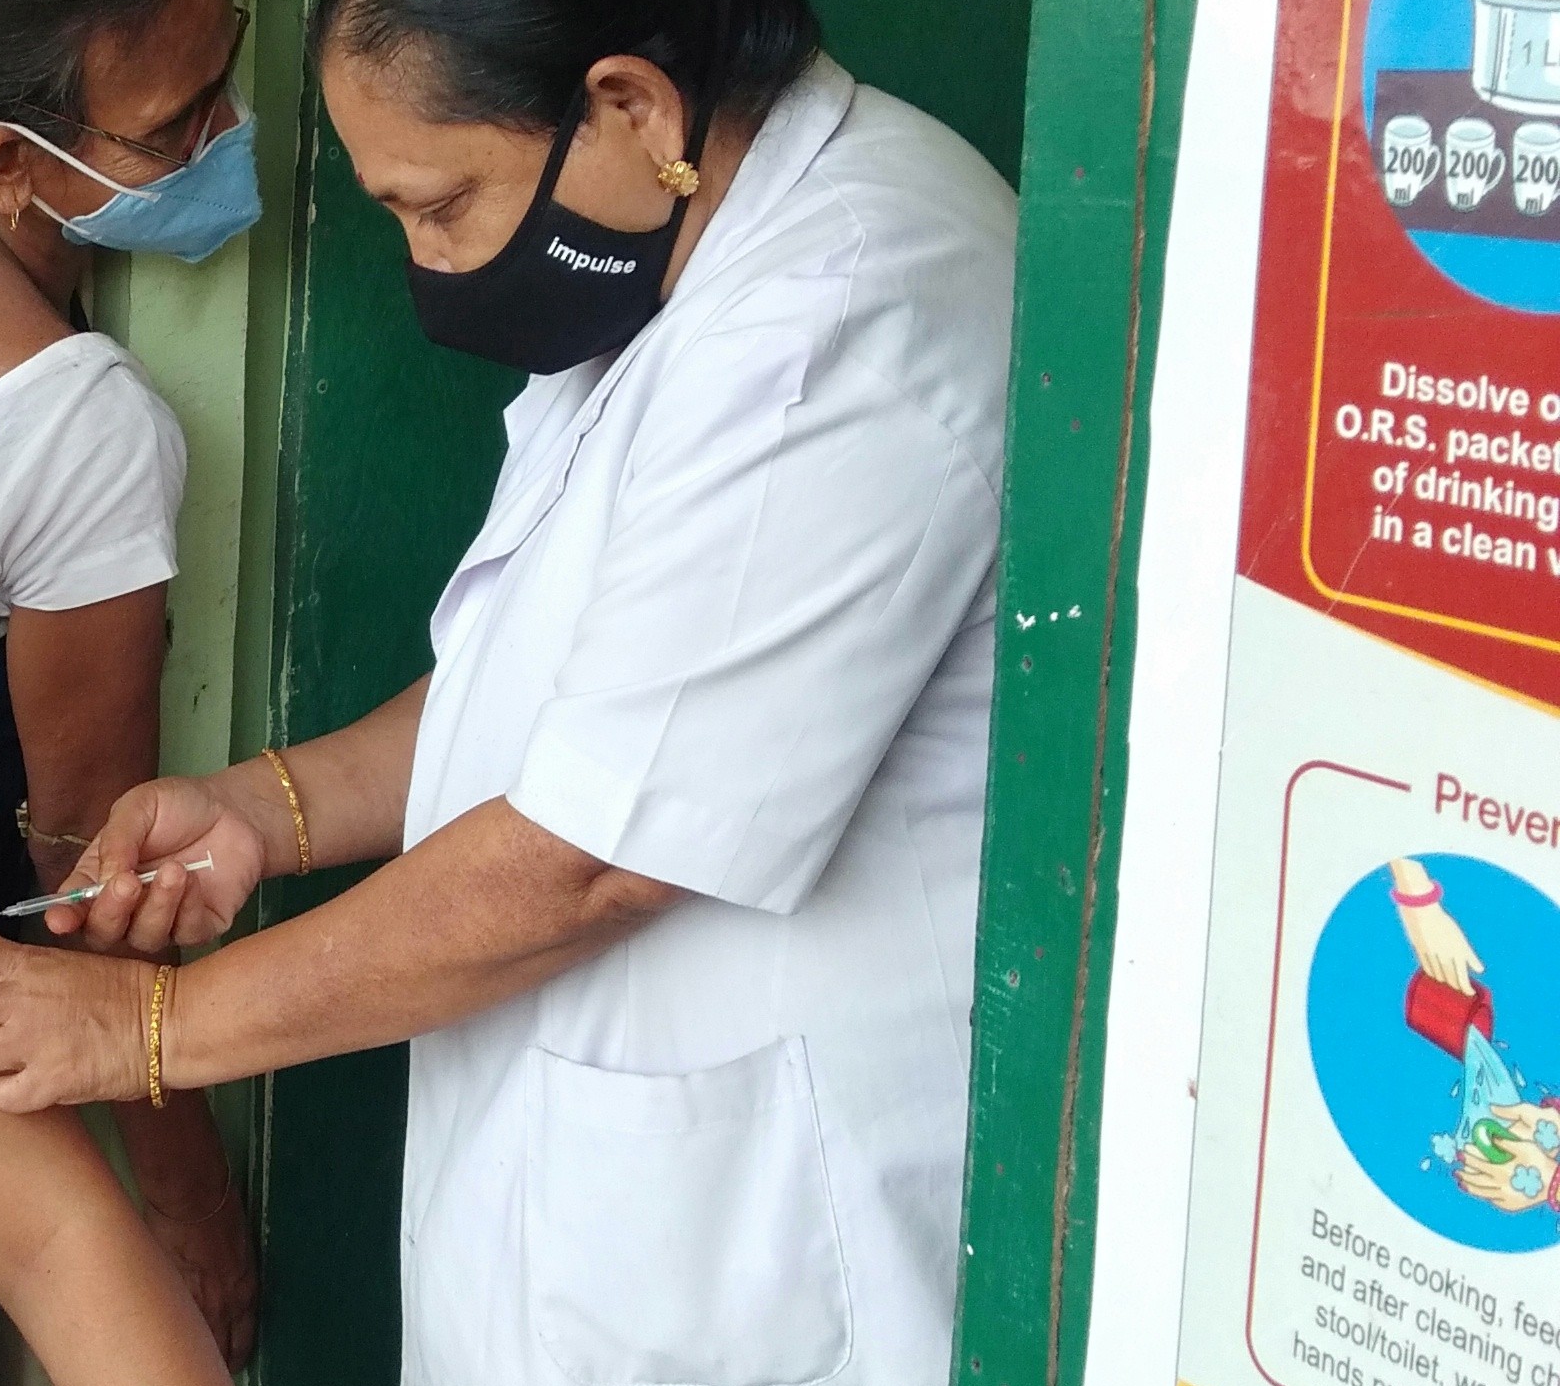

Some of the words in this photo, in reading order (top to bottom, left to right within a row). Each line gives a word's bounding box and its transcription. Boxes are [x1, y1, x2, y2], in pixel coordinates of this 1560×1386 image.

[1385, 146, 1427, 176] 200
[1448, 150, 1491, 180] 200
[1516, 154, 1558, 184] 200
[1393, 185, 1411, 204] ml
[1457, 189, 1475, 208] ml
[1525, 193, 1543, 213] ml
[546, 236, 637, 274] impulse
[1381, 361, 1530, 416] Dissolve
[1335, 403, 1437, 451] O.R.S.
[1373, 461, 1410, 495] of
[1414, 467, 1558, 532] drinking
[1372, 505, 1403, 543] in
[1412, 520, 1433, 550] a
[1442, 522, 1537, 571] clean
[1312, 1208, 1391, 1269] Before
[1399, 1252, 1504, 1326] cooking,
[1515, 1301, 1560, 1351] fee
[1301, 1253, 1346, 1294] and
[1354, 1278, 1410, 1321] after
[1416, 1307, 1523, 1385] cleaning
